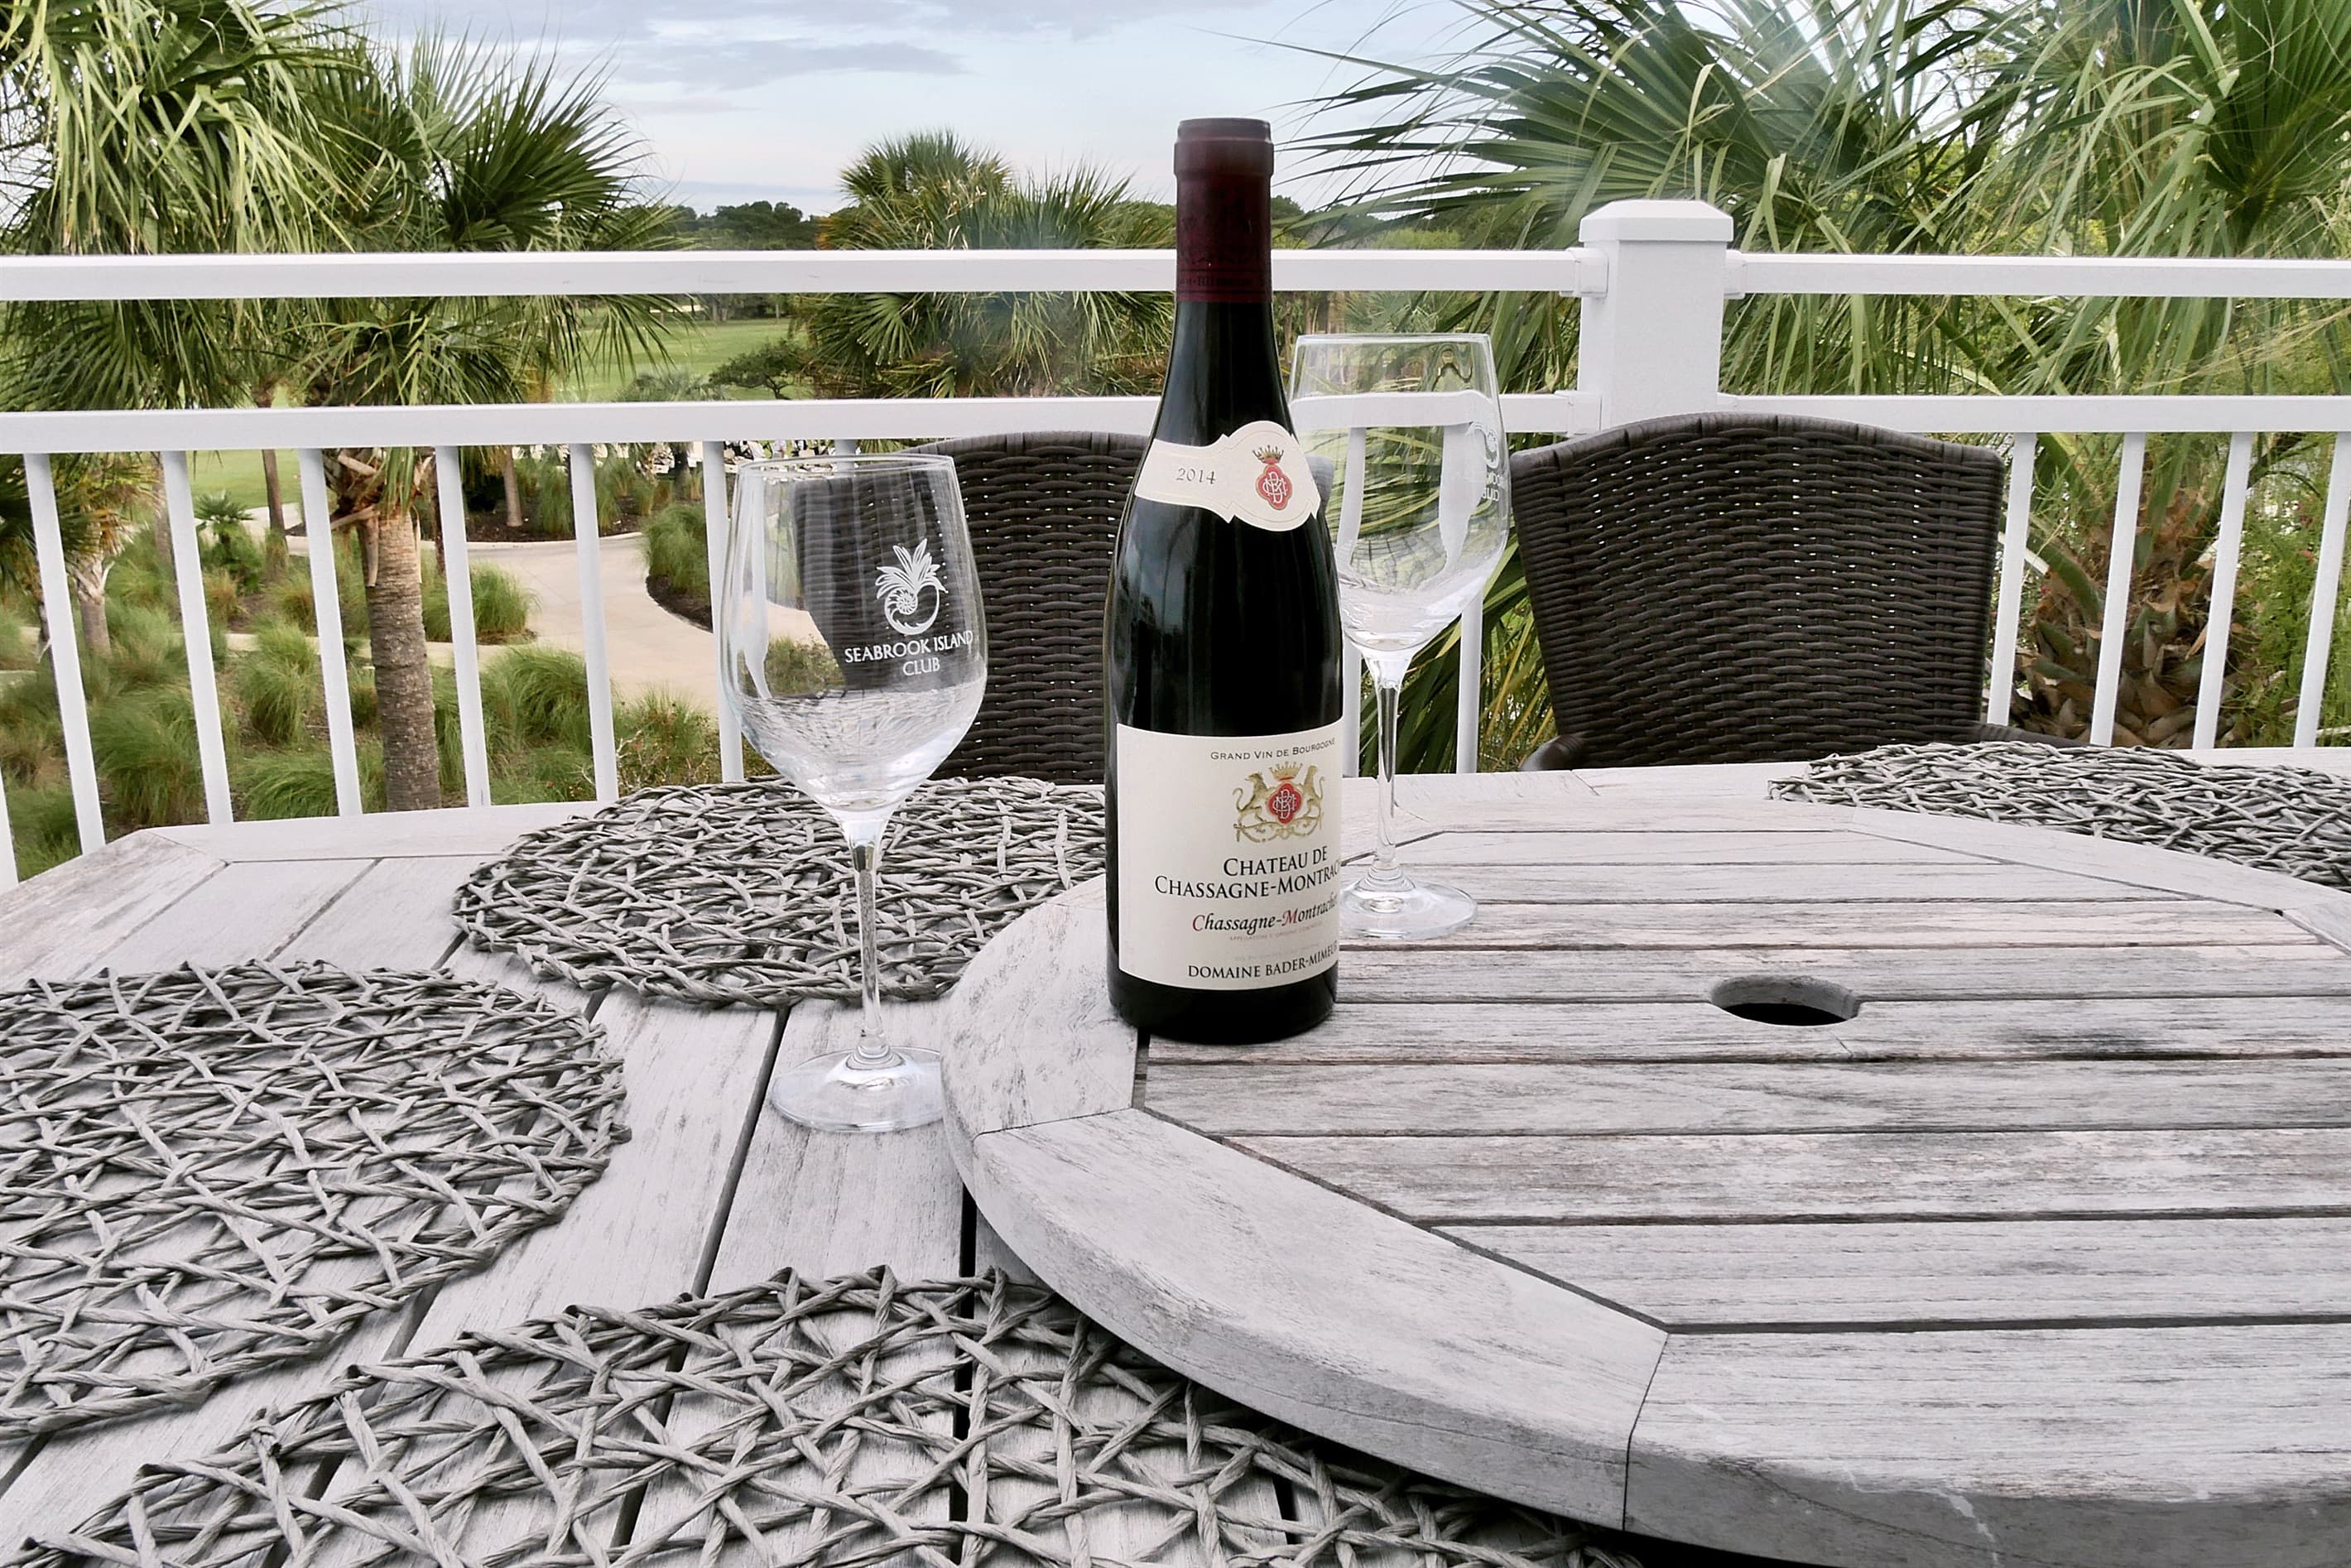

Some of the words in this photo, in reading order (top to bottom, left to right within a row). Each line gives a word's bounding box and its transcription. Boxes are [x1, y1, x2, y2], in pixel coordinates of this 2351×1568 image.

[1176, 467, 1216, 485] 2014
[844, 638, 931, 663] SEABROOK
[933, 630, 974, 652] ISLAND
[902, 657, 940, 676] CLUB
[1210, 751, 1251, 761] GRAND
[1253, 750, 1273, 759] VIN
[1276, 748, 1290, 758] DE
[1292, 738, 1336, 755] BOURGOGNE
[1223, 852, 1308, 877] CHATEAU
[1312, 845, 1328, 865] DE
[1188, 965, 1261, 979] DOMAINE
